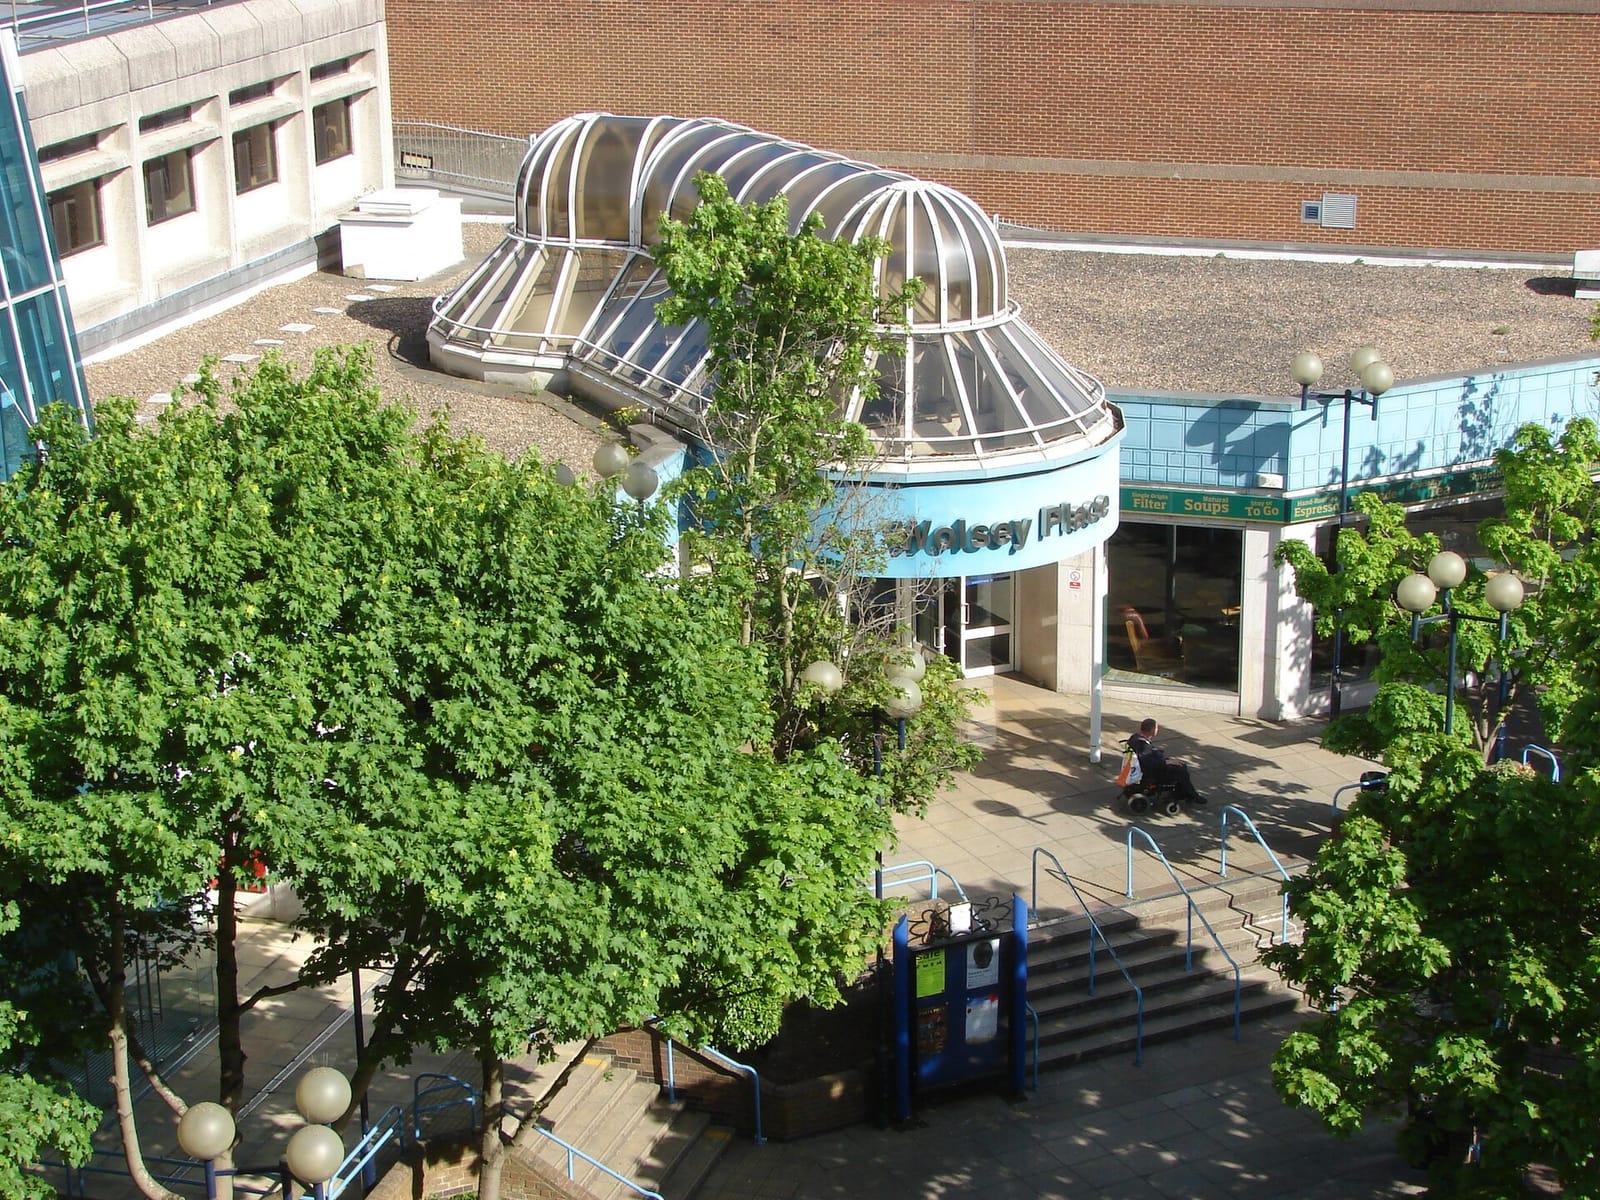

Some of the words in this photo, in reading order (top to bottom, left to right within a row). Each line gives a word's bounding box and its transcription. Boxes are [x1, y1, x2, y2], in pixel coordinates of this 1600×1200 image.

[1133, 498, 1167, 510] Filter
[1184, 498, 1229, 515] Soups
[1245, 506, 1261, 517] To
[1263, 506, 1279, 516] Go
[1294, 503, 1340, 518] Espresso
[1038, 494, 1110, 541] Place
